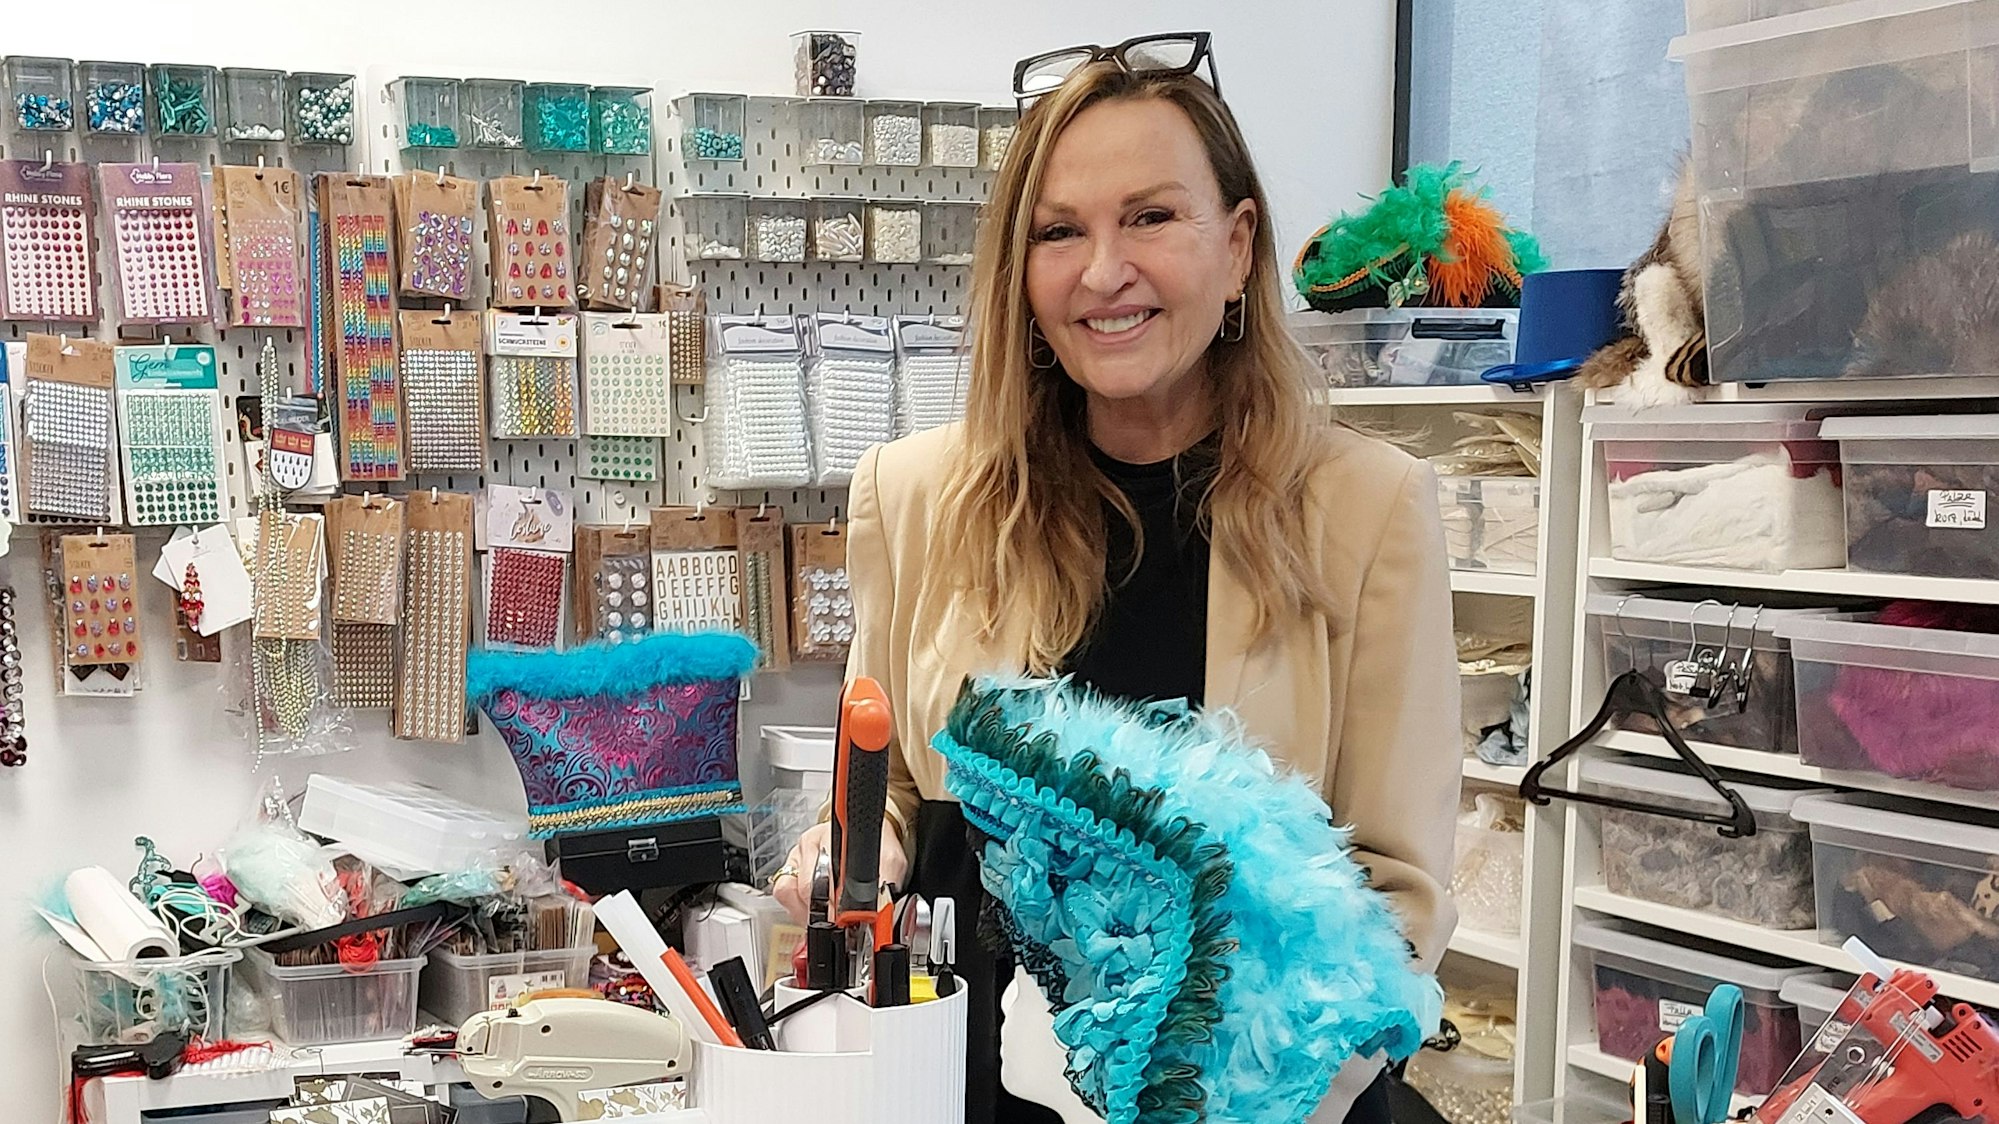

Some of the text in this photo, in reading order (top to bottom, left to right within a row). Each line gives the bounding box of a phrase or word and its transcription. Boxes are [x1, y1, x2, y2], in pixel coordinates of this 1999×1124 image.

[273, 180, 290, 194] 1€
[4, 192, 83, 206] RHINE STONES
[116, 195, 193, 207] RHINE STONES
